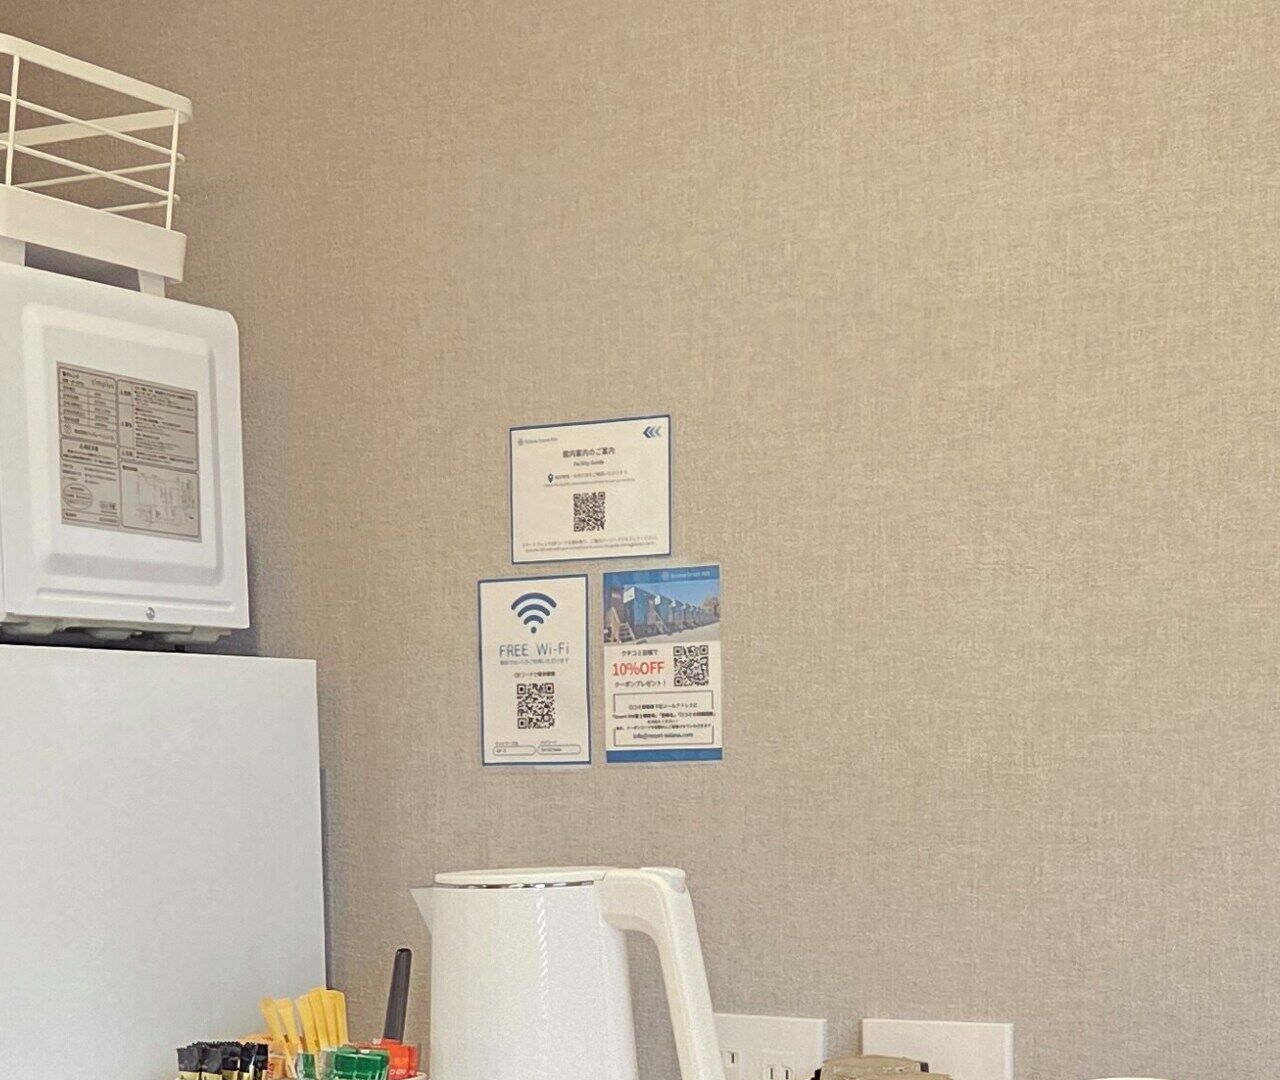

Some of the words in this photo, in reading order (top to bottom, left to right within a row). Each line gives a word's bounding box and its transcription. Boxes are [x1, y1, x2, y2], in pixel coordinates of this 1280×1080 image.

[499, 643, 529, 657] FREE
[536, 642, 570, 656] Wi-Fi
[612, 661, 665, 676] 10%OFF
